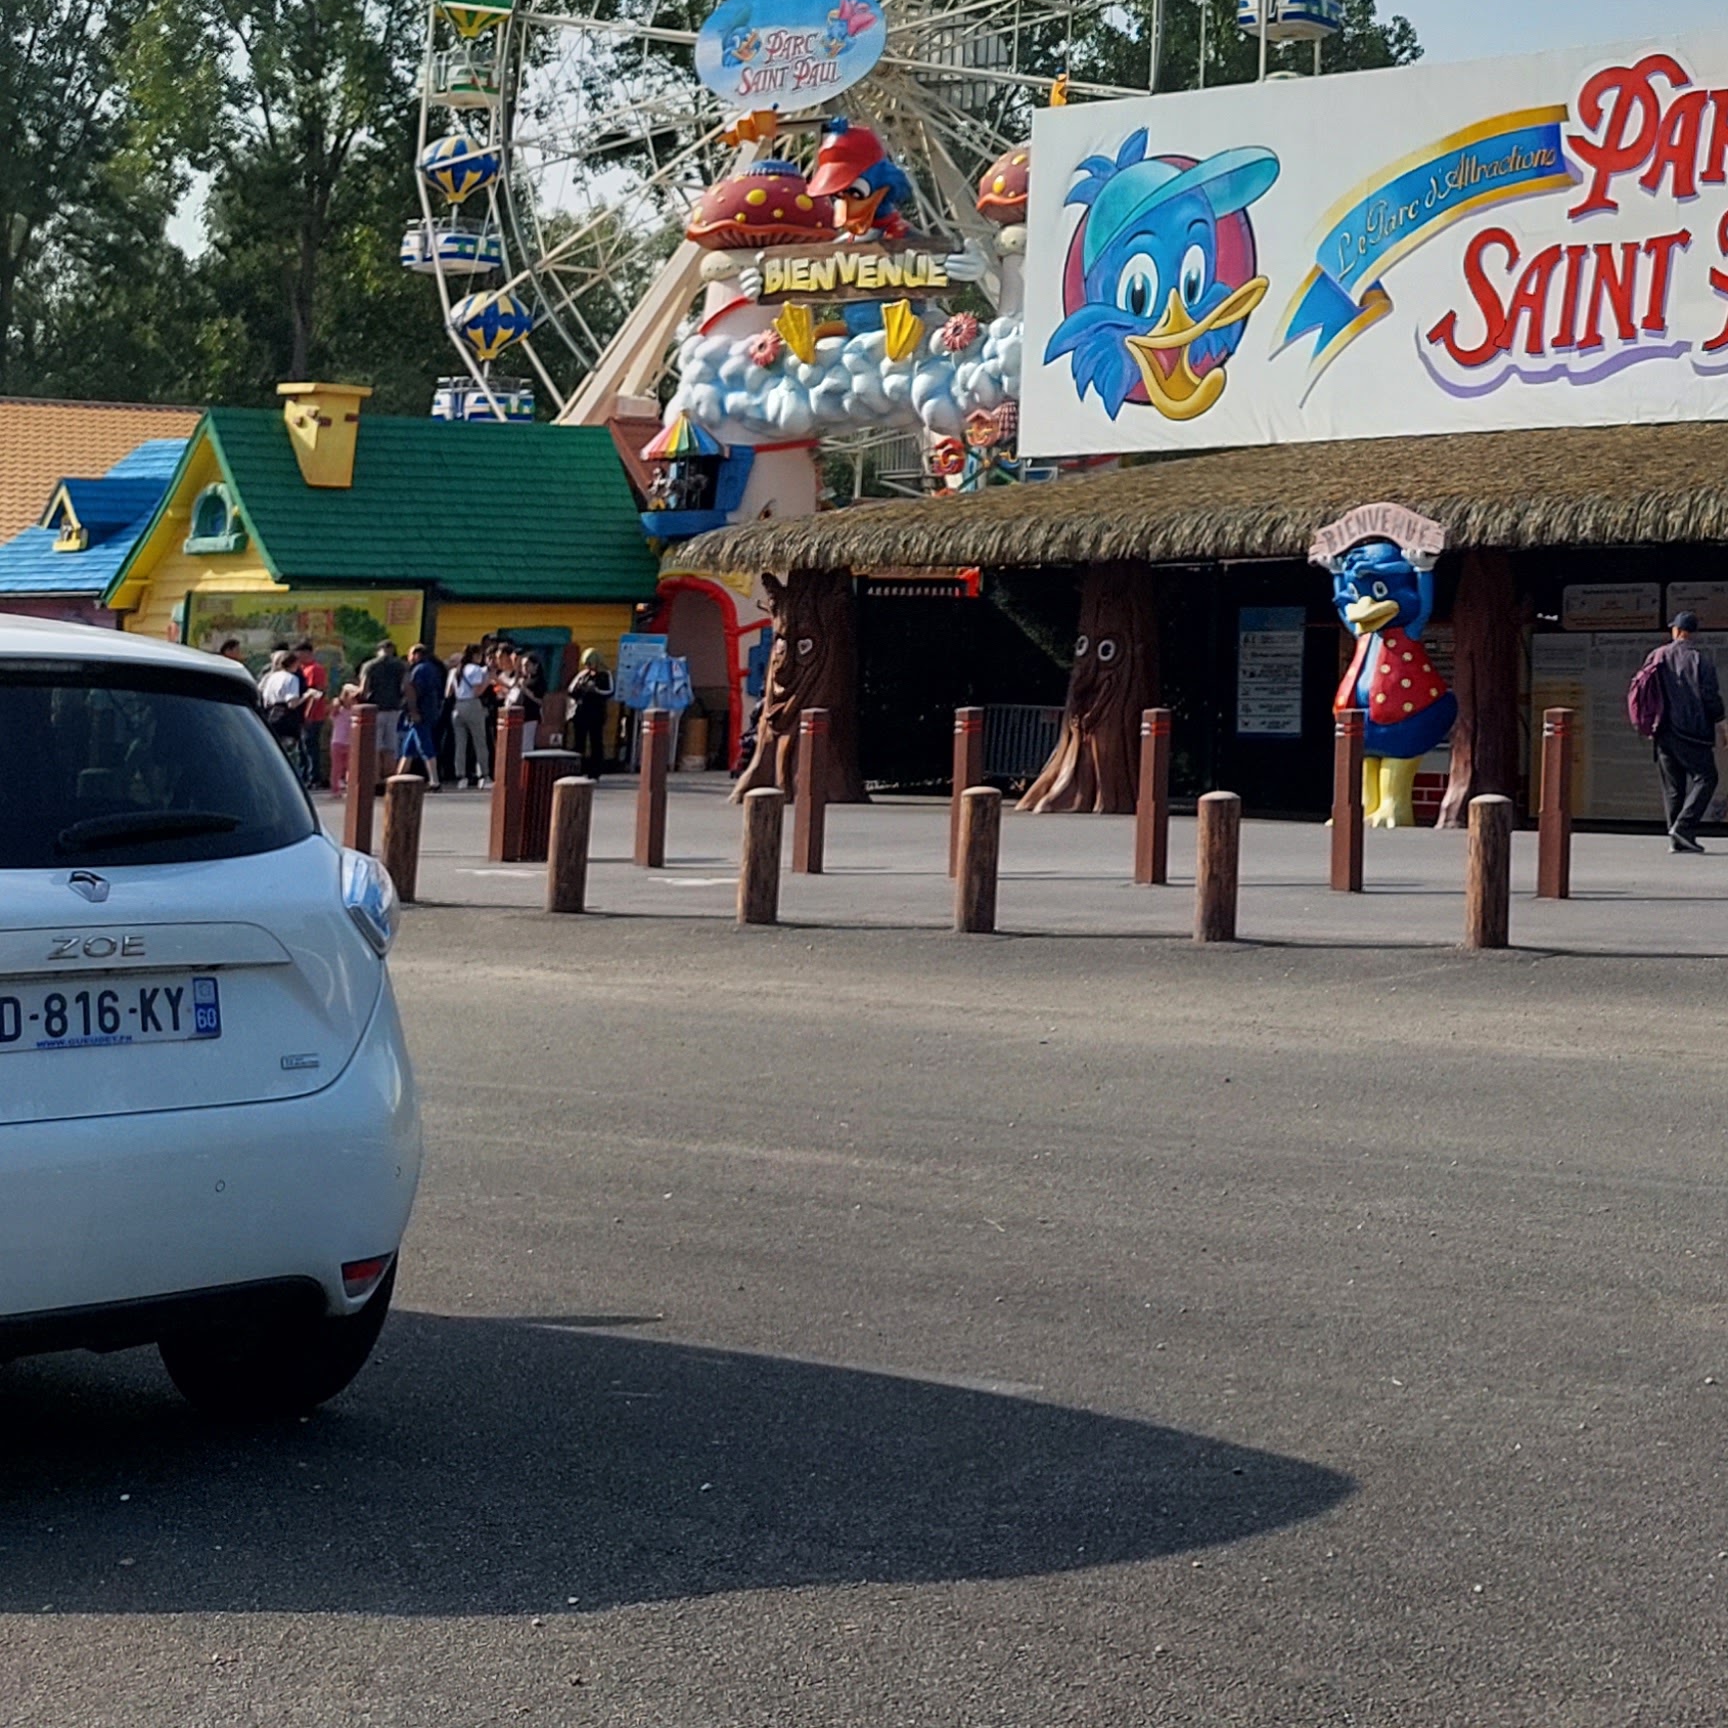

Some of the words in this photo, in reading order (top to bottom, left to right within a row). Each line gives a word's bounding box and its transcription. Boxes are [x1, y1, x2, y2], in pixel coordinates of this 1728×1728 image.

[764, 29, 818, 65] PARC
[736, 66, 790, 97] SAINT
[792, 55, 842, 92] PAUL
[1336, 231, 1367, 283] Le
[1366, 198, 1420, 245] Parc
[763, 248, 949, 296] BIENVENUE
[1426, 227, 1692, 367] SAINT
[1321, 505, 1431, 553] BIENVENUE
[47, 935, 146, 961] ZOE
[196, 1007, 218, 1028] 60
